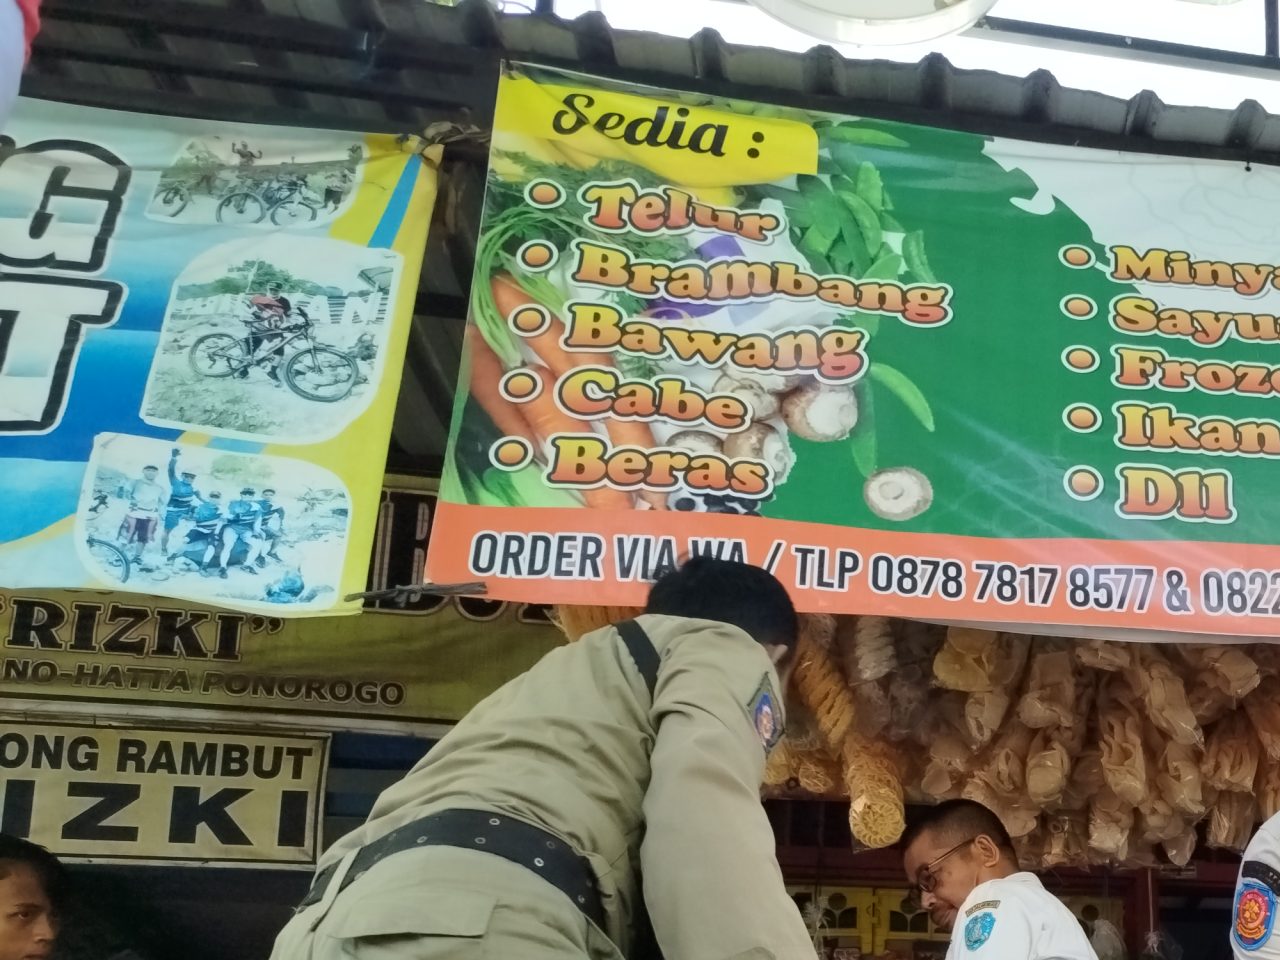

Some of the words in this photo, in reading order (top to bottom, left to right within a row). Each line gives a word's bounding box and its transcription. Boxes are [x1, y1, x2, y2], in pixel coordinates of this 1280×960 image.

[551, 92, 728, 158] Sedia
[580, 182, 781, 242] Telur
[573, 242, 947, 324] Brambang
[565, 304, 867, 381] Bawang
[558, 368, 750, 429] Cabe
[549, 435, 770, 497] Beras
[1120, 467, 1233, 521] Dll
[469, 532, 605, 579] ORDER
[615, 536, 676, 581] VIA
[765, 541, 785, 574] /
[794, 546, 862, 590] TLP
[870, 555, 964, 599] 0878
[974, 562, 1059, 606] 7817
[1068, 566, 1157, 612] 8577
[1165, 568, 1192, 614] &
[201, 672, 405, 708] PONOROGO
[116, 737, 313, 781] RAMBUT
